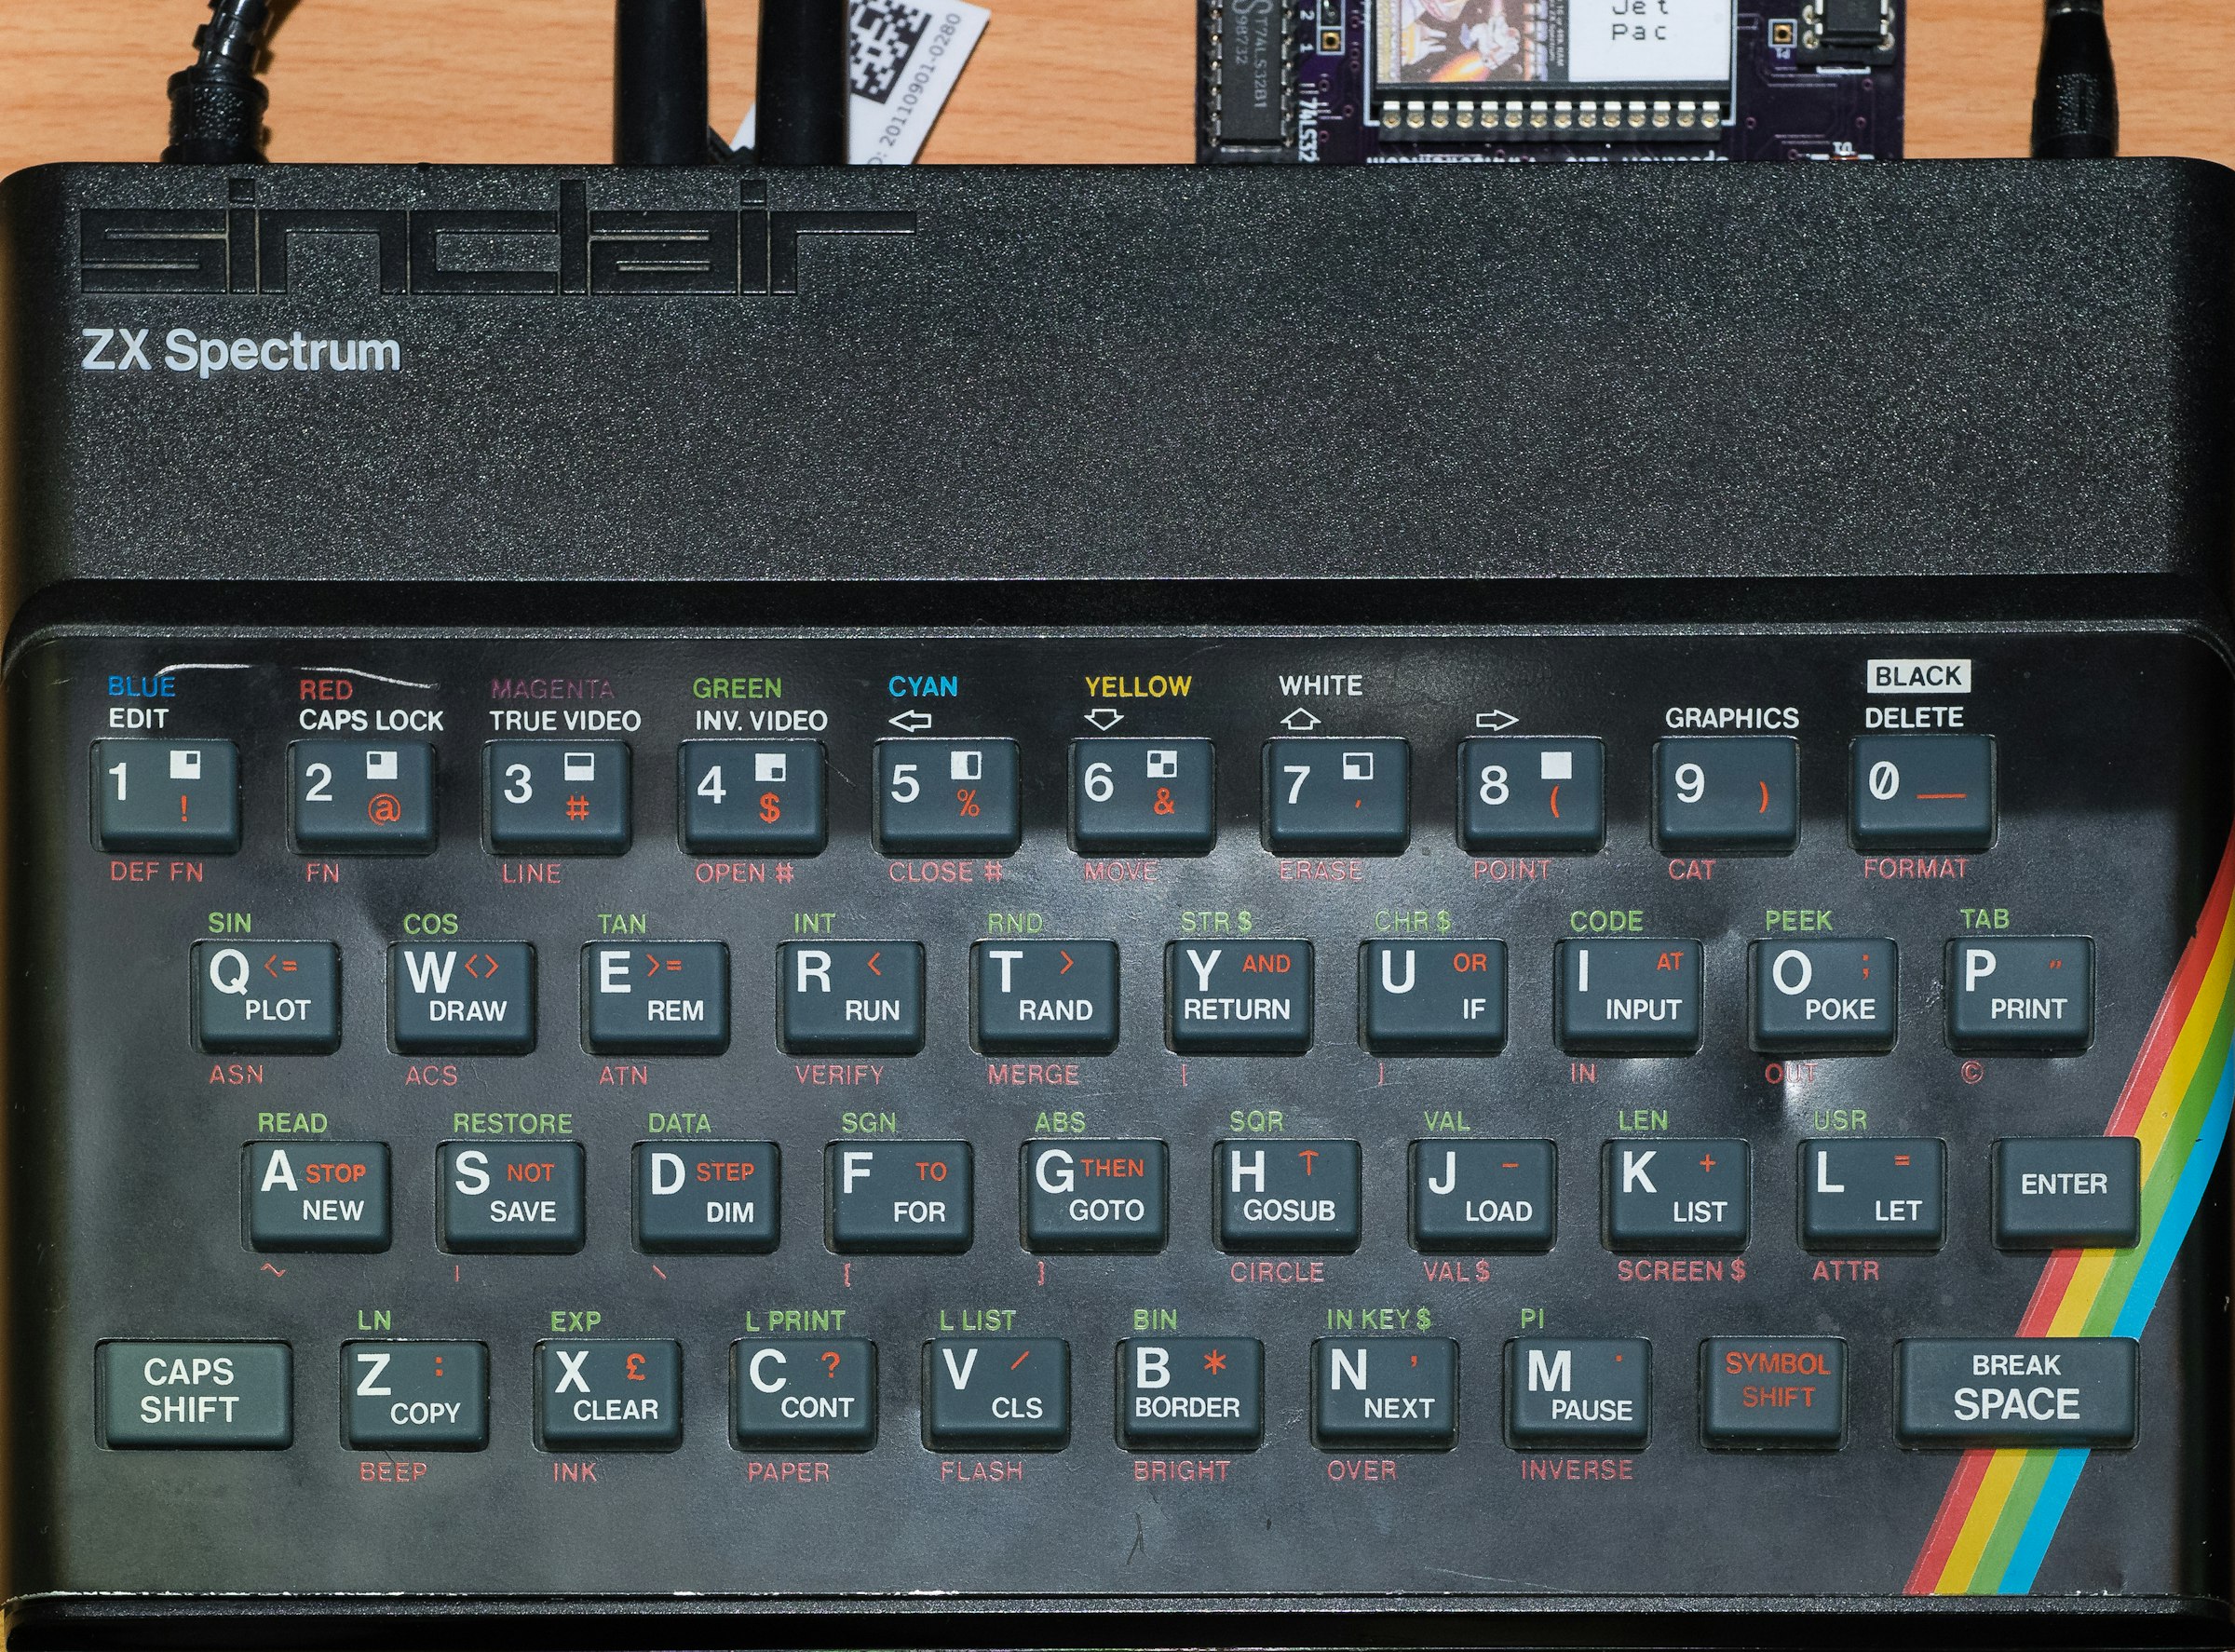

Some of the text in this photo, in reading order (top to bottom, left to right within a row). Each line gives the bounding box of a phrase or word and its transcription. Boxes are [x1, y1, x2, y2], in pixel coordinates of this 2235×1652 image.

[1300, 10, 1315, 20] 2
[1612, 23, 1666, 40] Pac
[879, 13, 961, 146] 20110901-0280
[1298, 97, 1318, 162] 74LS32
[80, 178, 917, 295] sinclair
[82, 329, 401, 377] ZX Spectrum
[1086, 675, 1192, 697] YELLOW
[1280, 675, 1362, 696] WHITE
[1876, 666, 1961, 685] BLACK
[108, 676, 175, 697] BLUE
[300, 680, 353, 700] RED
[492, 678, 615, 699] MAGENTA
[693, 678, 781, 698] GREEN
[889, 676, 957, 697] CYAN
[110, 708, 169, 728] EDIT
[300, 709, 443, 731] CAPS LOCK
[490, 711, 641, 731] TRUE VIDEO
[697, 710, 828, 731] INV. VIDEO
[1666, 708, 1799, 729] GRAPHICS
[1866, 707, 1963, 728] DELETE
[109, 763, 126, 800] 1
[305, 764, 332, 801] 2
[505, 764, 532, 803] 3
[698, 766, 726, 804] 4
[891, 765, 919, 803] 5
[1085, 763, 1113, 802] 6
[1284, 765, 1310, 804] 7
[1480, 765, 1509, 805] 8
[1675, 764, 1704, 803] 9
[111, 860, 202, 882] DEF FN
[306, 863, 338, 883] FN
[503, 863, 561, 883] LINE
[695, 862, 765, 883] OPEN
[887, 861, 976, 884] CLOSE
[1085, 861, 1158, 882] MOVE
[1280, 860, 1366, 885] ERASE
[1474, 860, 1551, 883] POINT
[1669, 859, 1716, 880] CAT
[1865, 856, 1969, 879] FORMAT
[209, 913, 251, 933] SIN
[403, 914, 458, 934] COS
[598, 914, 645, 934] TAN
[794, 913, 835, 933] INT
[987, 911, 1044, 933] RND
[1570, 910, 1643, 932] CODE
[1767, 910, 1833, 931] PEEK
[1960, 909, 2010, 928] TAB
[1186, 950, 1221, 991] Y
[1242, 955, 1291, 972] AND
[1454, 953, 1486, 972] OR
[1657, 952, 1683, 969] AT
[1966, 950, 1996, 991] P
[210, 949, 249, 995] Q
[404, 951, 456, 993] W
[601, 951, 630, 993] E
[798, 951, 831, 992] R
[990, 951, 1023, 993] T
[1382, 950, 1415, 994] U
[1773, 950, 1811, 995] O
[246, 999, 311, 1021] PLOT
[430, 1001, 507, 1021] DRAW
[648, 1000, 703, 1021] REM
[847, 1000, 900, 1021] RUN
[1020, 1000, 1092, 1020] RAND
[1185, 998, 1290, 1020] RETURN
[1464, 999, 1485, 1019] IF
[1607, 999, 1682, 1020] INPUT
[1807, 998, 1875, 1020] POKE
[1992, 998, 2067, 1019] PRINT
[210, 1064, 263, 1084] ASN
[406, 1065, 457, 1086] ACS
[599, 1065, 647, 1085] ATN
[795, 1063, 883, 1086] VERIFY
[988, 1063, 1079, 1085] MERGE
[1571, 1063, 1596, 1084] IN
[1766, 1063, 1822, 1084] OUT
[258, 1113, 327, 1132] READ
[454, 1113, 572, 1134] RESTORE
[648, 1113, 711, 1133] DATA
[842, 1112, 896, 1133] SGN
[1036, 1111, 1085, 1133] ABS
[1230, 1110, 1282, 1131] SQR
[1424, 1111, 1470, 1132] VAL
[1619, 1109, 1669, 1132] LEN
[1814, 1106, 1866, 1131] USR
[261, 1150, 298, 1191] A
[306, 1163, 365, 1183] STOP
[455, 1151, 490, 1195] S
[508, 1163, 555, 1182] NOT
[652, 1153, 685, 1195] D
[697, 1162, 754, 1181] STEP
[844, 1152, 873, 1193] F
[916, 1162, 947, 1181] TO
[1036, 1149, 1074, 1193] G
[1081, 1158, 1144, 1177] THEN
[1232, 1151, 1265, 1192] H
[1429, 1152, 1456, 1194] J
[1623, 1151, 1657, 1193] K
[1818, 1151, 1844, 1192] L
[2023, 1173, 2107, 1194] ENTER
[304, 1200, 364, 1220] NEW
[491, 1200, 556, 1222] SAVE
[708, 1202, 753, 1223] DIM
[895, 1201, 945, 1223] FOR
[1070, 1199, 1144, 1221] GOTO
[1243, 1199, 1335, 1222] GOSUB
[1467, 1200, 1533, 1222] LOAD
[1674, 1201, 1727, 1223] LIST
[1876, 1200, 1922, 1221] LET
[1230, 1261, 1325, 1284] CIRCLE
[1619, 1260, 1723, 1281] SCREEN
[1812, 1261, 1878, 1280] ATTR
[359, 1310, 390, 1330] LN
[551, 1311, 601, 1332] EXP
[1133, 1309, 1177, 1330] BIN
[1522, 1308, 1544, 1328] PI
[144, 1358, 234, 1386] CAPS
[555, 1351, 590, 1392] X
[750, 1348, 786, 1392] C
[942, 1348, 978, 1389] V
[1137, 1347, 1170, 1388] B
[1332, 1348, 1366, 1389] N
[1529, 1350, 1571, 1391] M
[1727, 1351, 1830, 1374] SYMBOL
[1973, 1355, 2061, 1375] BREAK
[357, 1354, 391, 1395] Z
[781, 1397, 854, 1418] CONT
[992, 1397, 1042, 1418] CLS
[1136, 1396, 1239, 1417] BORDER
[1743, 1387, 1815, 1407] SHIFT
[1955, 1388, 2079, 1420] SPACE
[141, 1396, 239, 1423] SHIFT
[391, 1402, 460, 1424] COPY
[574, 1400, 657, 1421] CLEAR
[1365, 1398, 1435, 1418] NEXT
[1552, 1400, 1632, 1421] PAUSE
[359, 1462, 427, 1482] BEEP
[554, 1462, 597, 1482] INK
[748, 1462, 829, 1483] PAPER
[941, 1460, 1023, 1482] FLASH
[1134, 1459, 1230, 1482] BRIGHT
[1327, 1459, 1396, 1481] OVER
[1522, 1459, 1632, 1481] INVERSE
